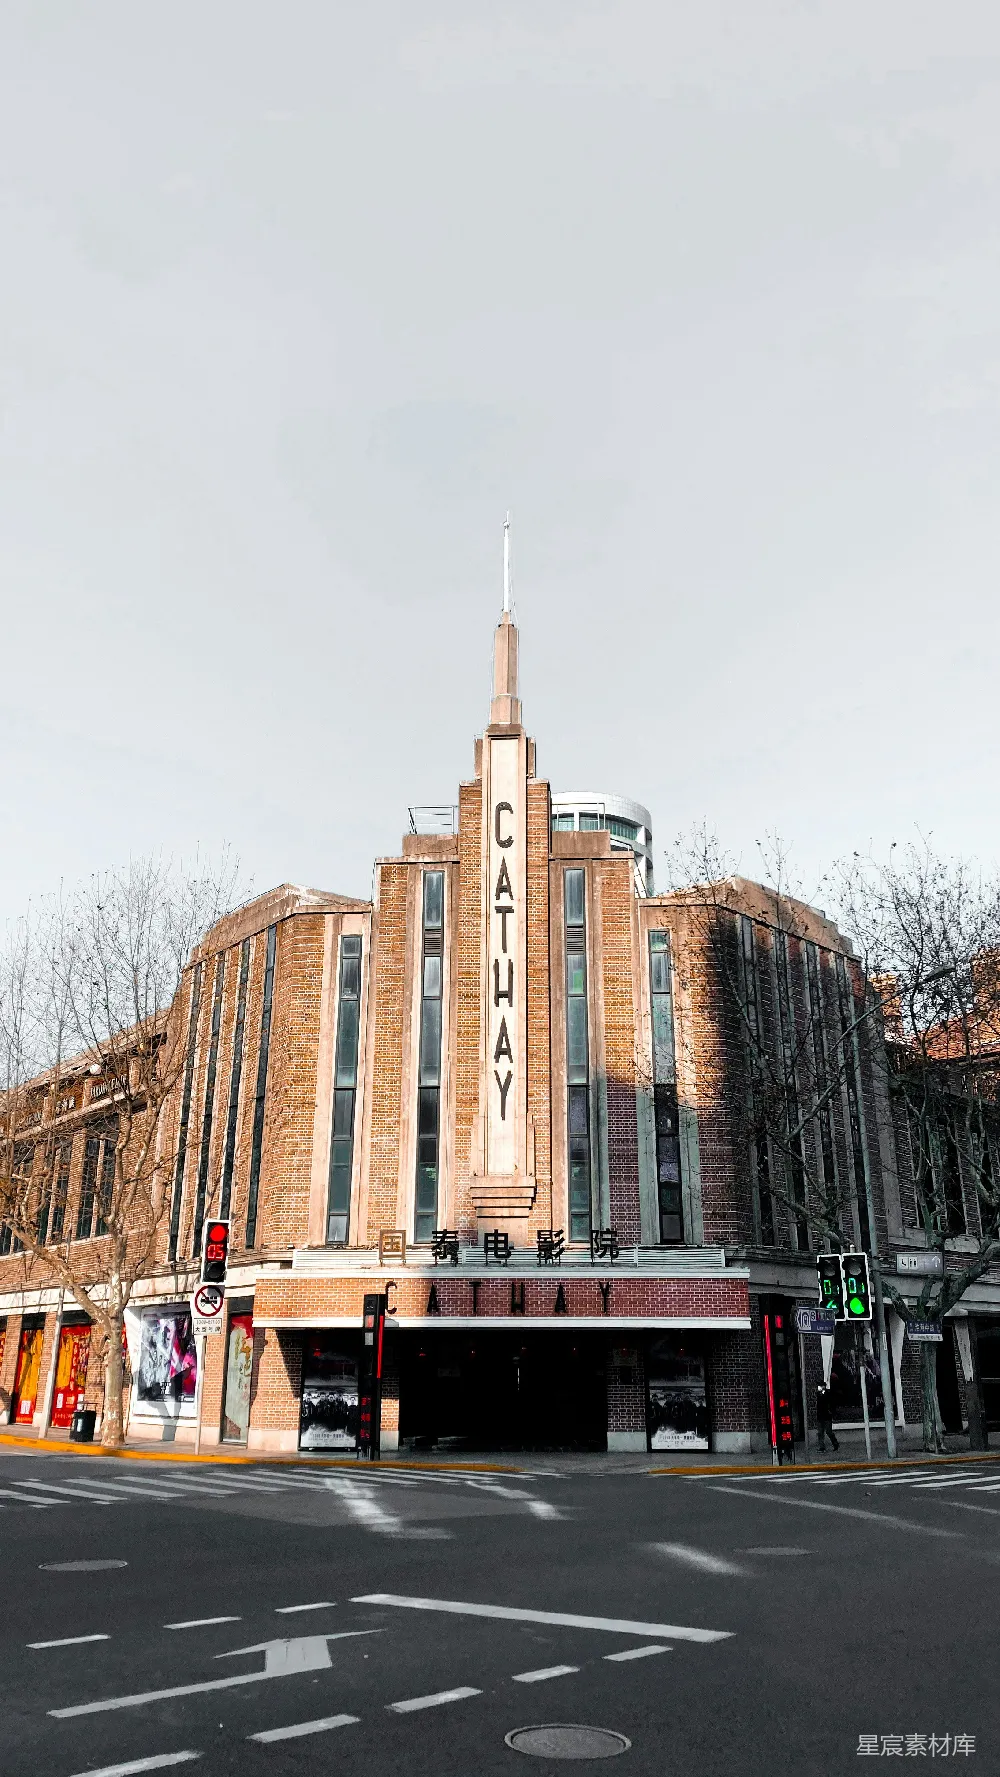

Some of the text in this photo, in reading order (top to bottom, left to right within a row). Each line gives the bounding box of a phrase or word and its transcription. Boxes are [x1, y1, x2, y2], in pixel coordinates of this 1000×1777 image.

[494, 801, 514, 1120] CATHAY
[378, 1228, 620, 1261] 国泰电影院
[385, 1281, 611, 1315] CATHAY
